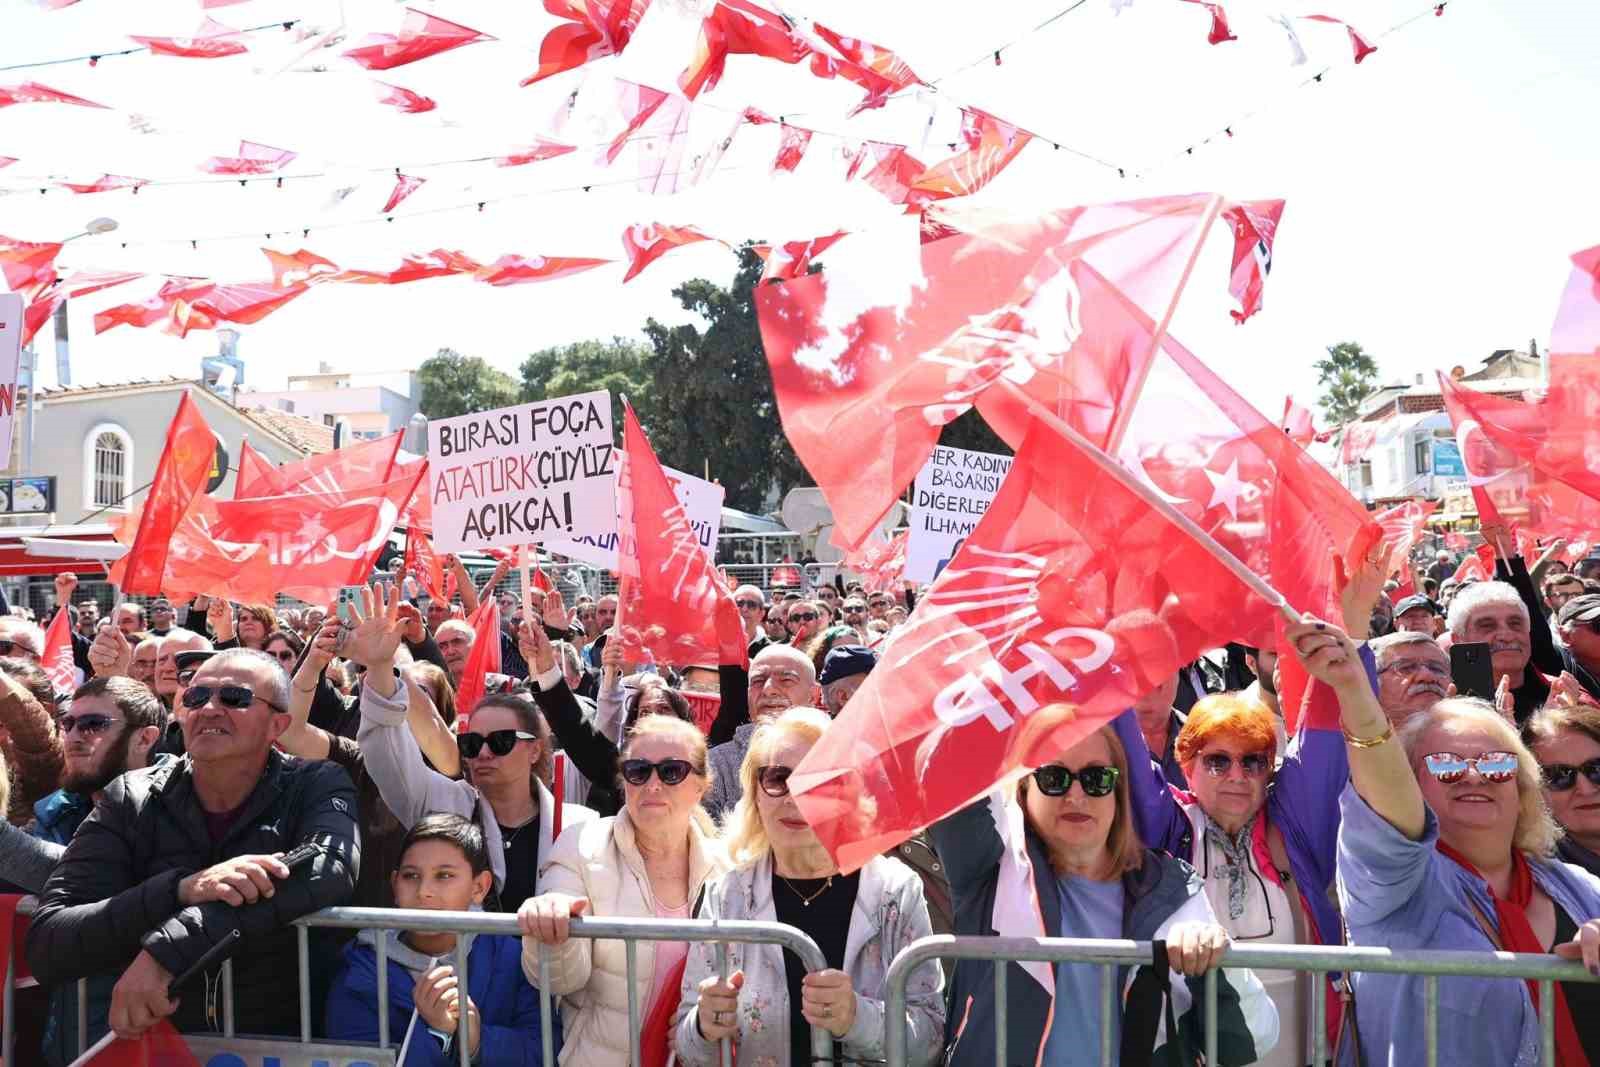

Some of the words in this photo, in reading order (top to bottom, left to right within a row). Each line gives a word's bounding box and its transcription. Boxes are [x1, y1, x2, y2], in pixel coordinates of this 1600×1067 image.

[439, 413, 518, 457] BURASI
[531, 399, 604, 441] FOÇA
[462, 491, 573, 541] AÇIKÇA!
[925, 512, 976, 535] İLHAM
